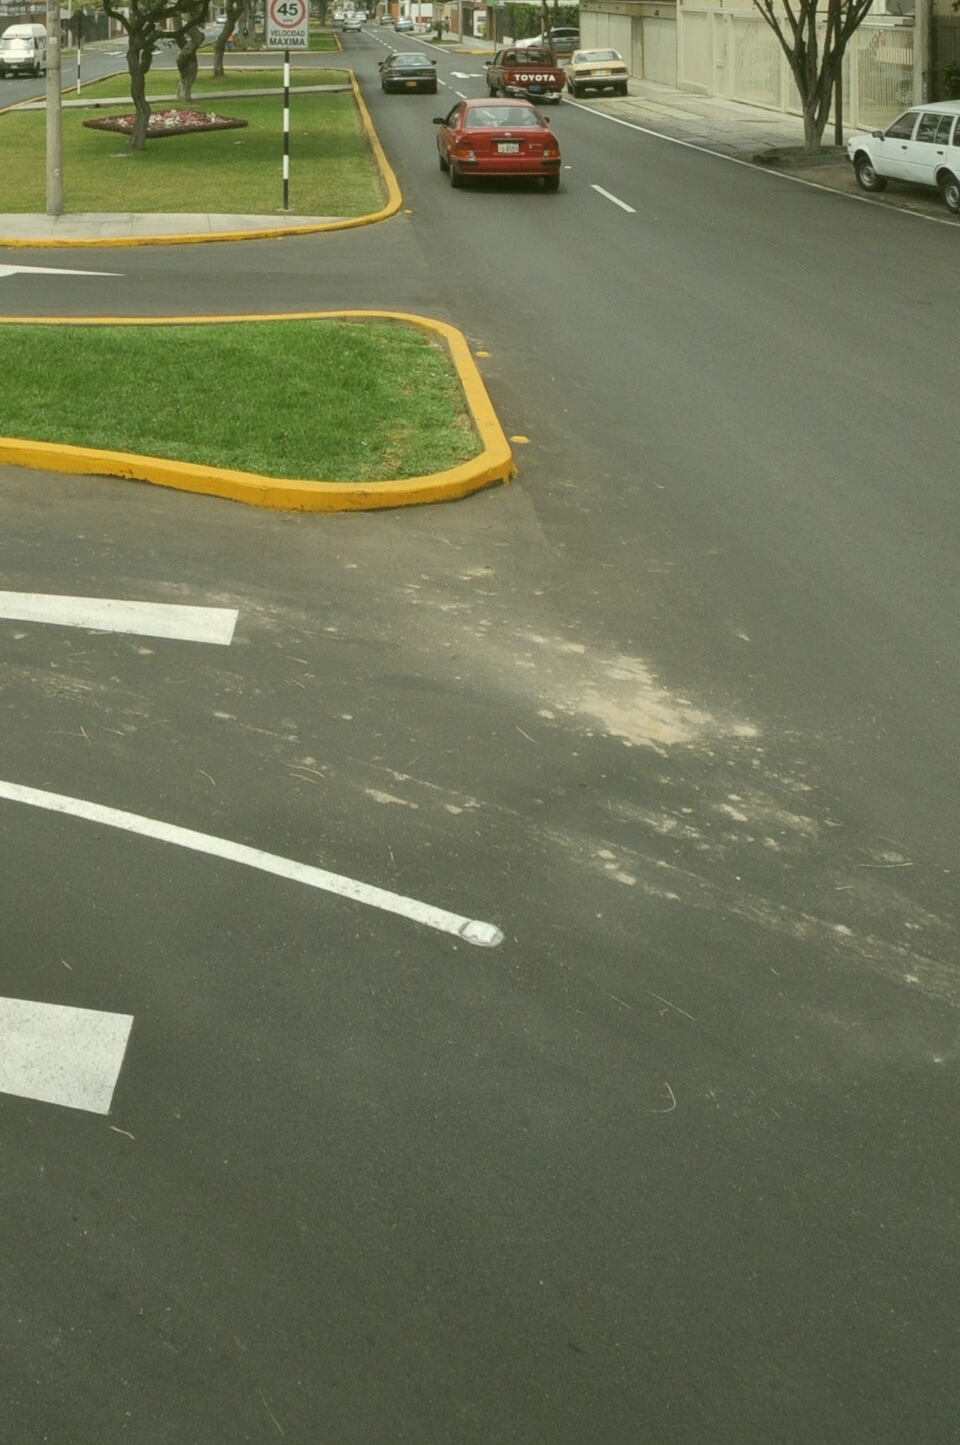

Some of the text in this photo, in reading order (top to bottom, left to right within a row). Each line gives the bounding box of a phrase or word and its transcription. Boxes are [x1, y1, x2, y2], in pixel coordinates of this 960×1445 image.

[277, 3, 298, 16] 45
[270, 38, 305, 46] MAXIMA
[514, 74, 556, 82] TOYOTA
